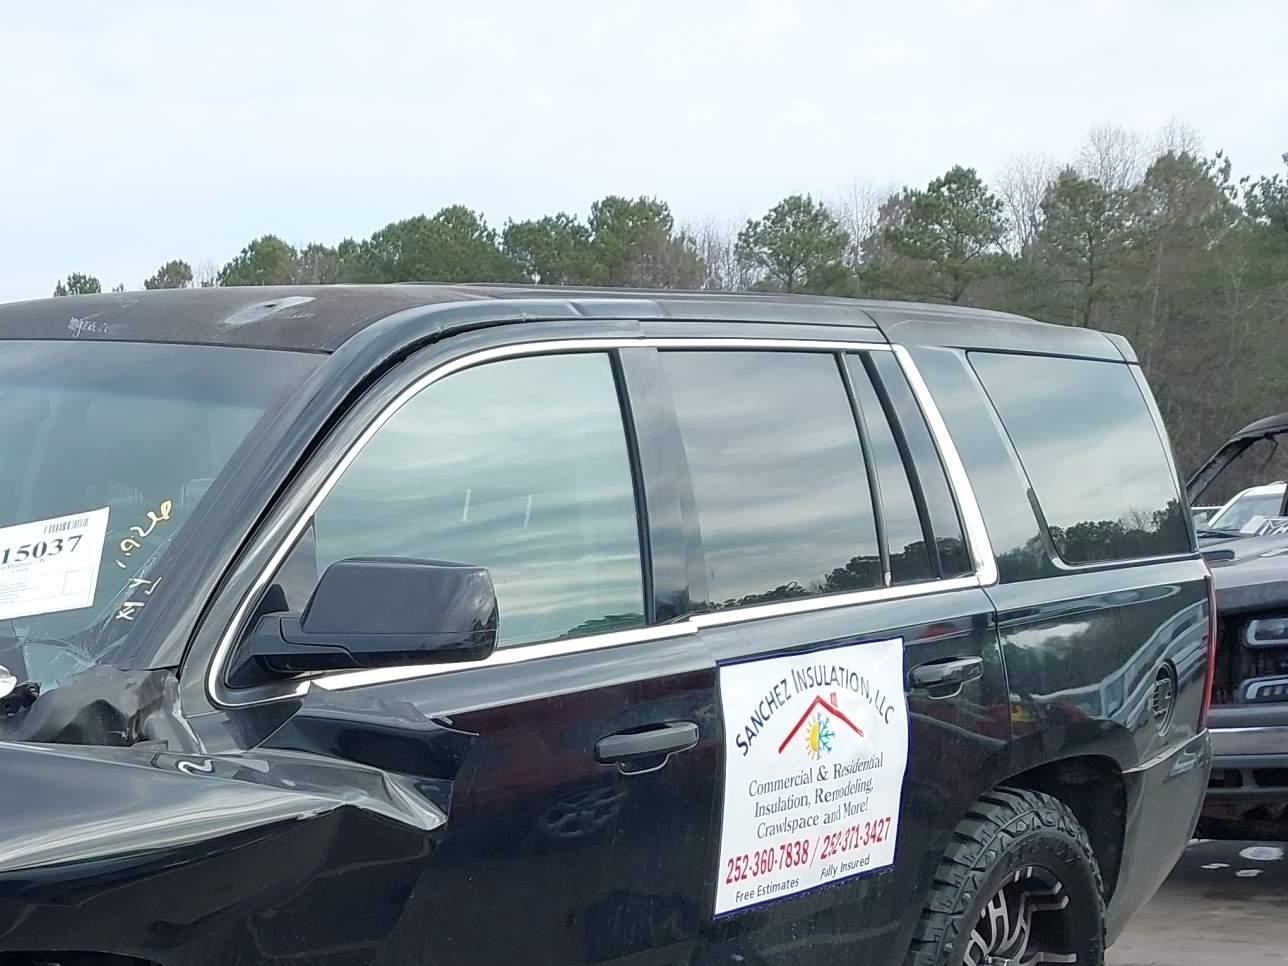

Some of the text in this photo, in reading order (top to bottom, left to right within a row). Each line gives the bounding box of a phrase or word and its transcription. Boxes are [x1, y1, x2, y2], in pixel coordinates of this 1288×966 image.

[736, 678, 792, 756] SANCHEZ
[873, 689, 895, 725] LLC
[749, 751, 884, 797] Commercial & Residential
[754, 795, 811, 818] Insulation,
[757, 797, 869, 839] Crawlspace and More!
[725, 839, 810, 885] 252-360-7838
[820, 817, 892, 861] 252-371-3427
[820, 854, 871, 881] Fully Insured
[735, 877, 800, 903] Free Estimates
